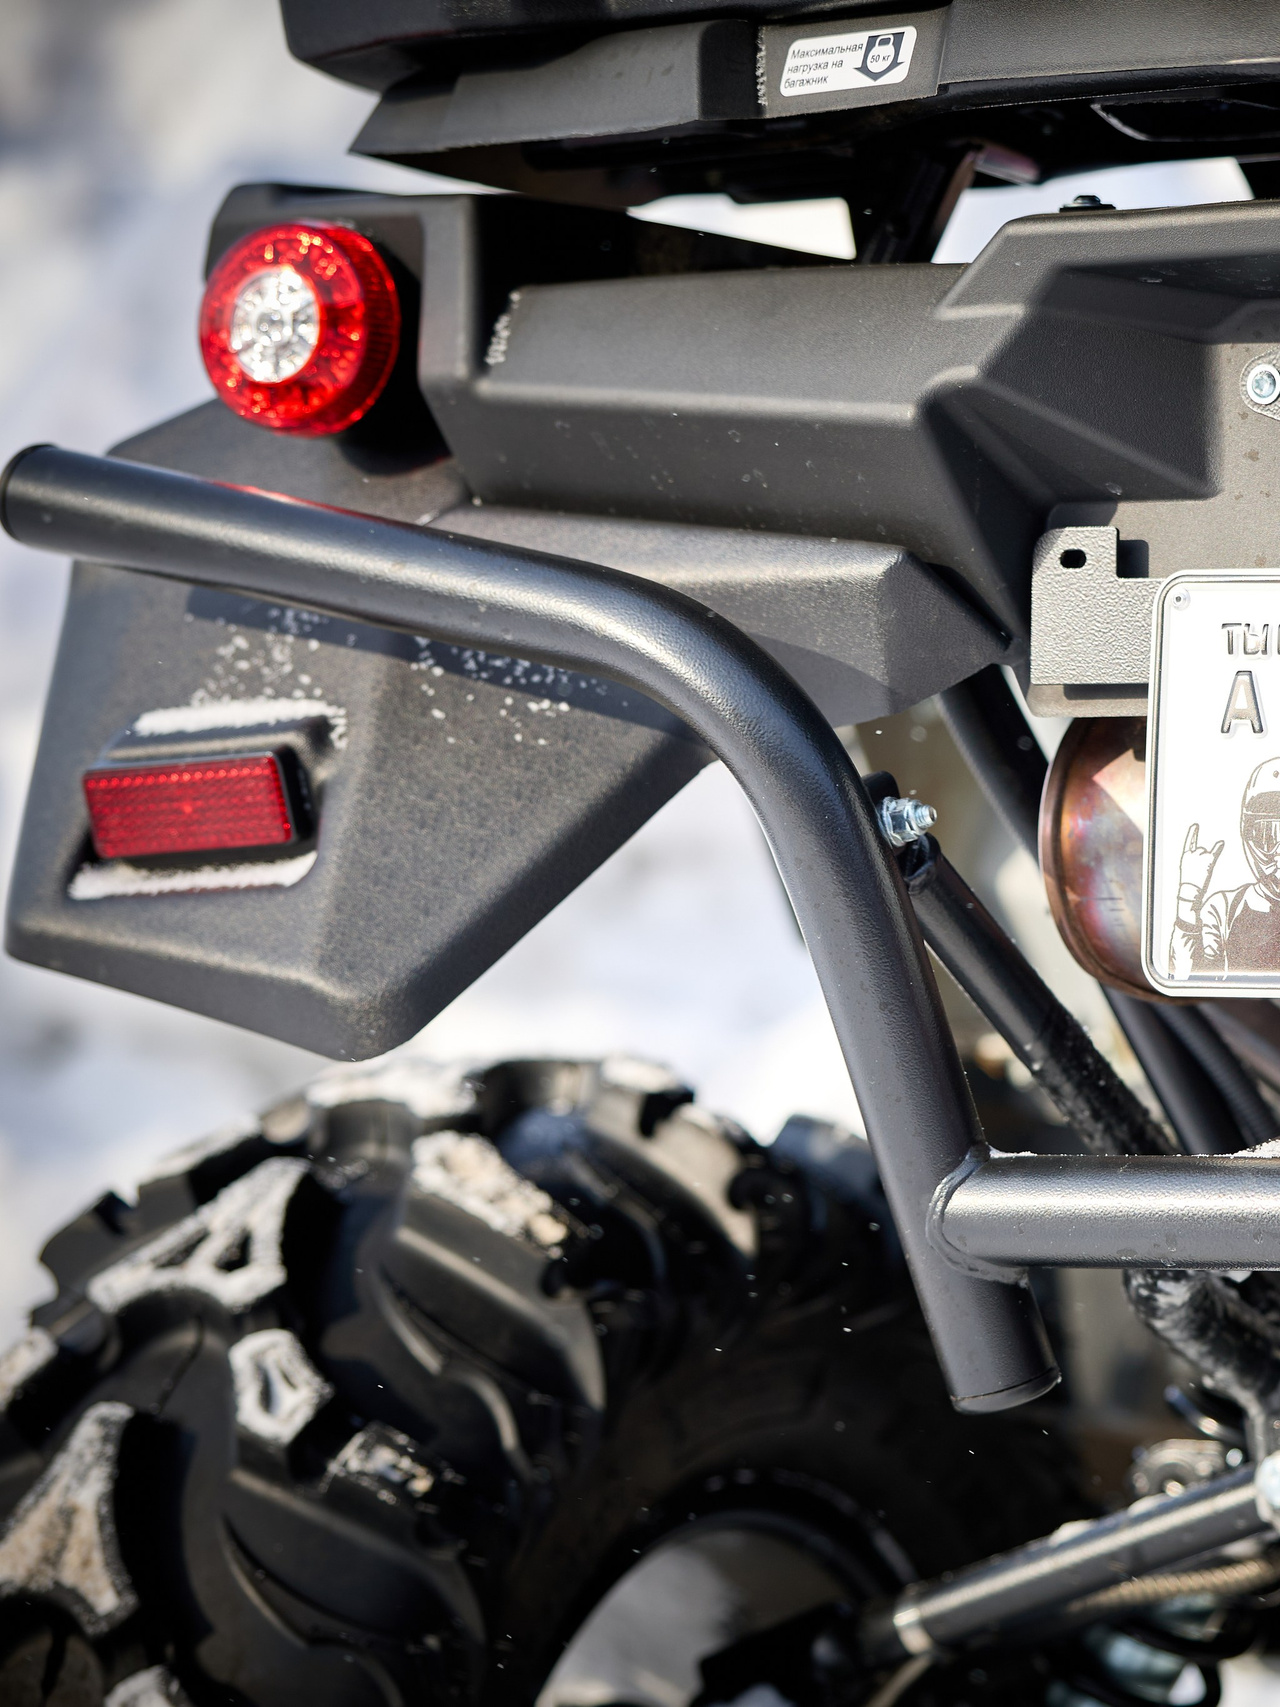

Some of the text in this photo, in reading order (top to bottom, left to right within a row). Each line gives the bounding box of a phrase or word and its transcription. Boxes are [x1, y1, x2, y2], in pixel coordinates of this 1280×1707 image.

[791, 42, 864, 60] Максимальная
[870, 53, 891, 63] 50 кг
[787, 59, 844, 75] нагрузка на
[784, 75, 829, 89] багажник
[1221, 623, 1269, 656] ТЫ
[1220, 670, 1264, 734] А
